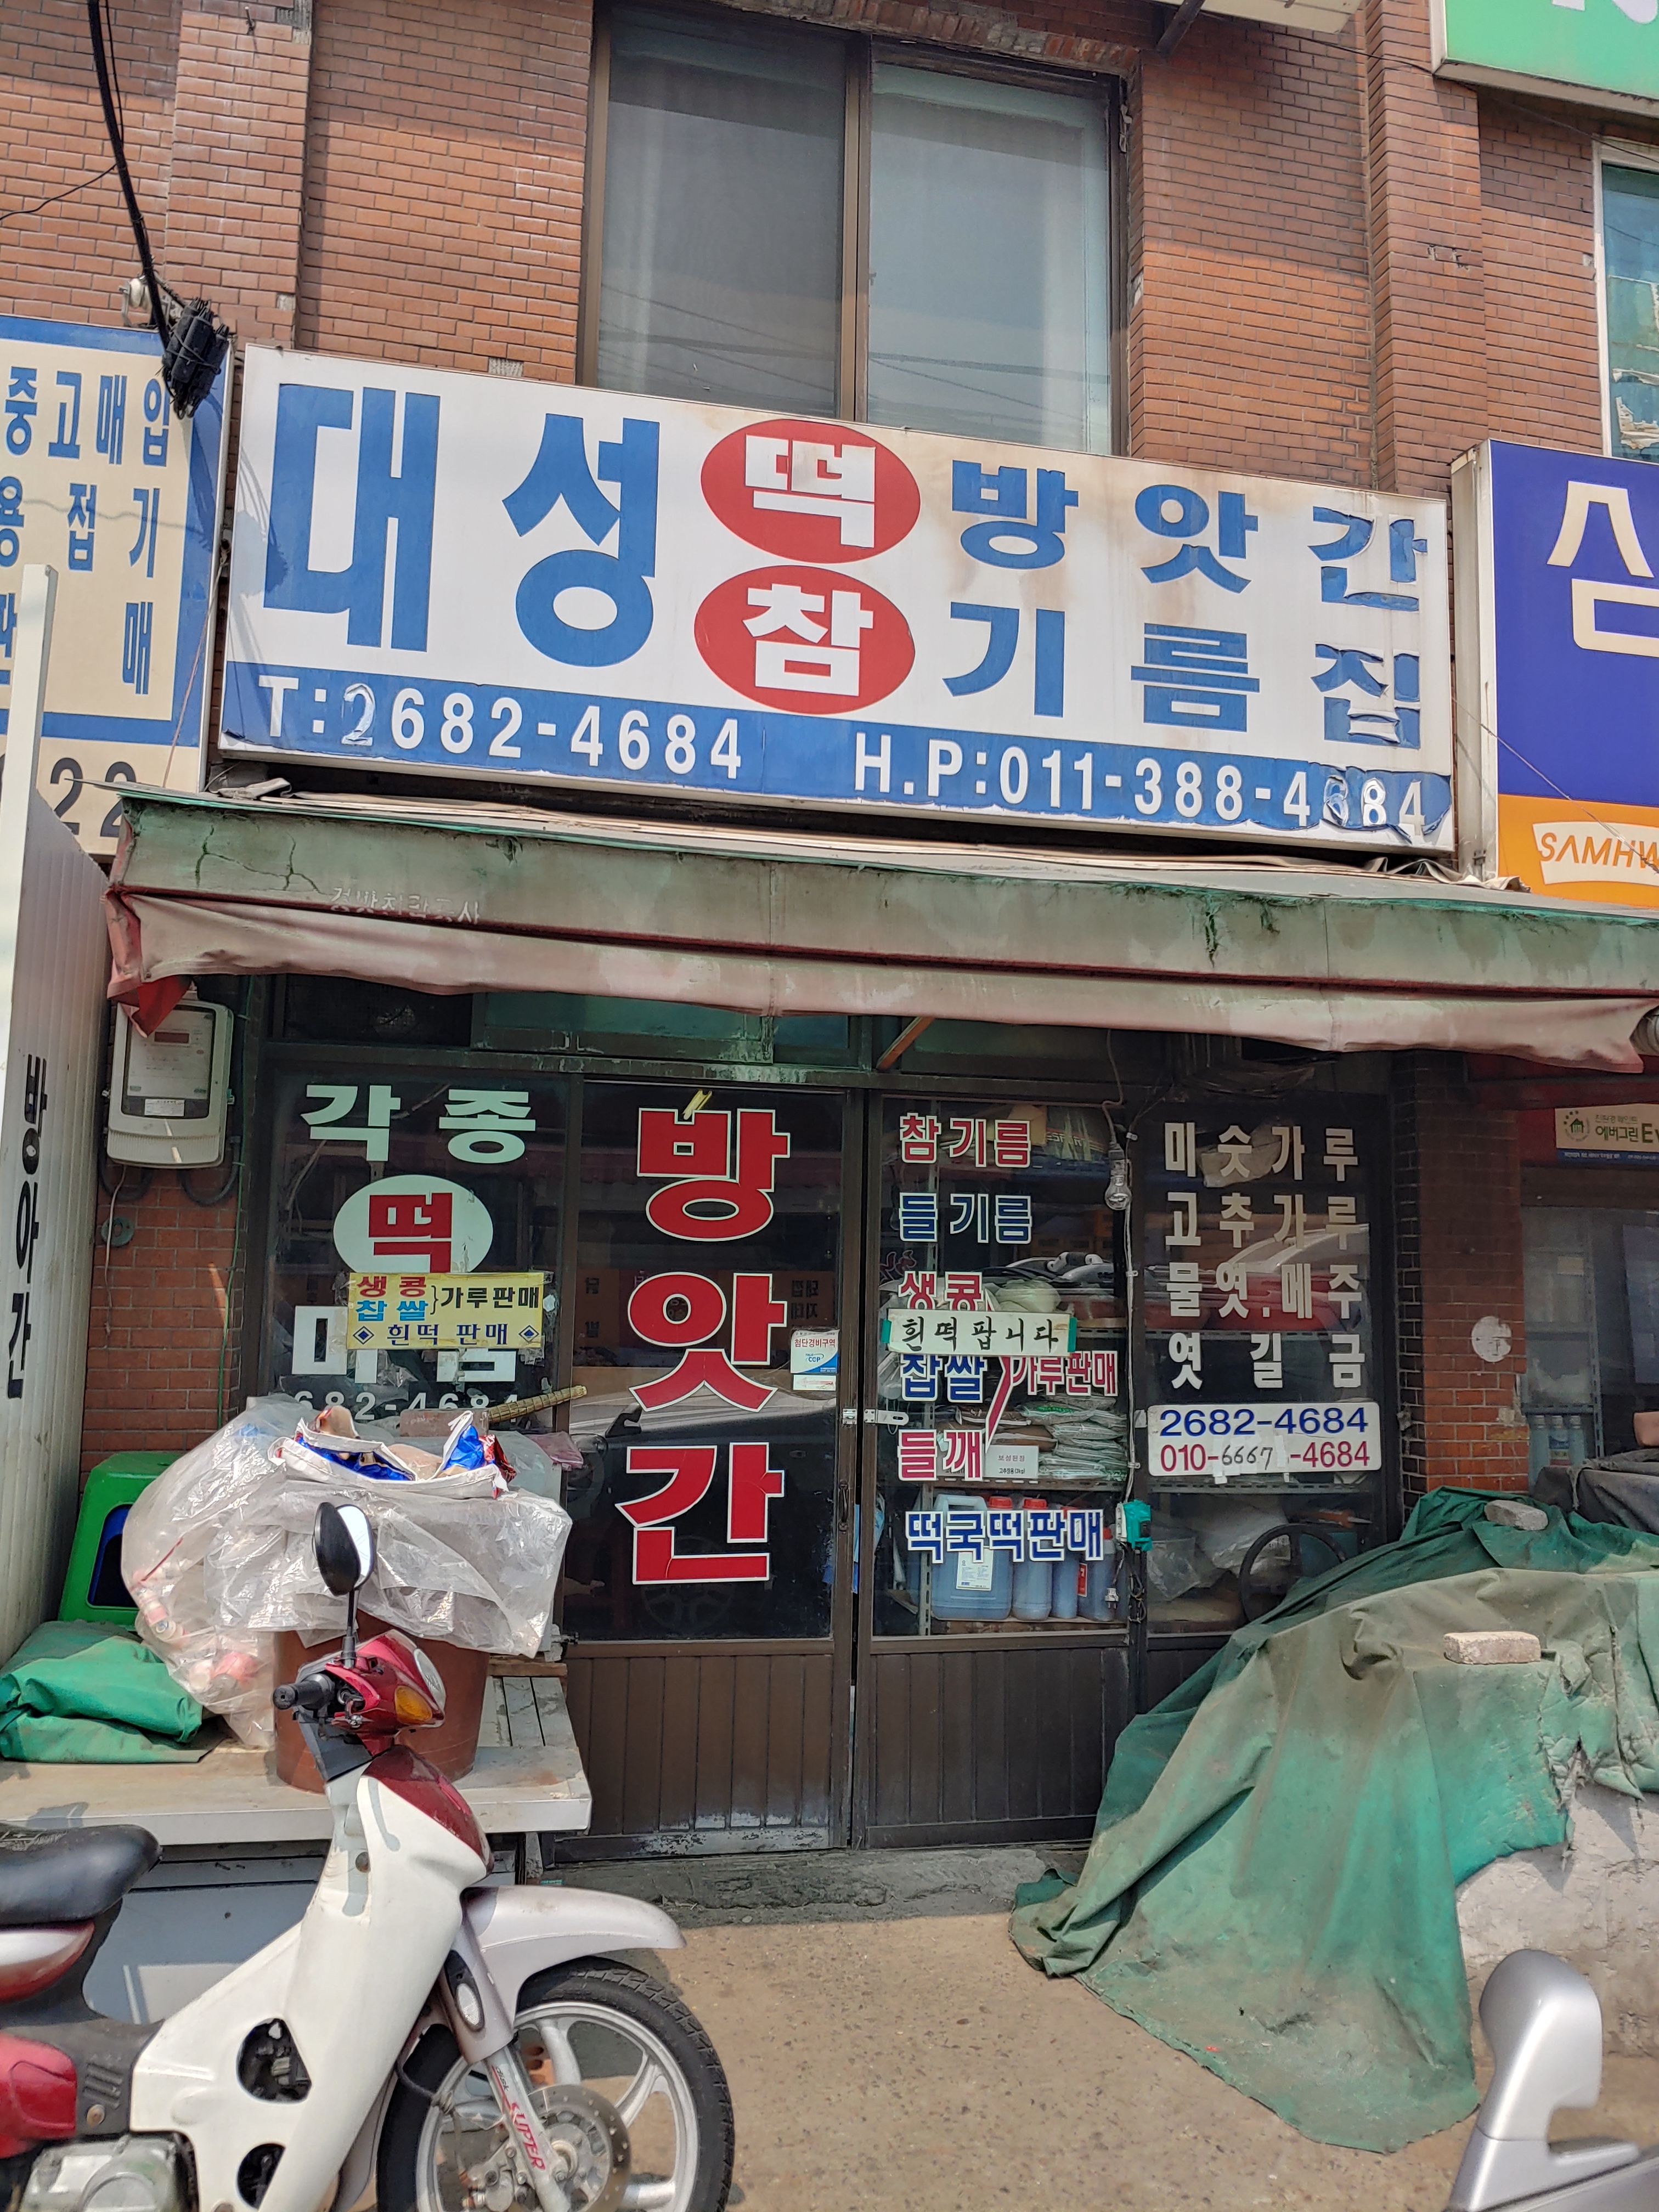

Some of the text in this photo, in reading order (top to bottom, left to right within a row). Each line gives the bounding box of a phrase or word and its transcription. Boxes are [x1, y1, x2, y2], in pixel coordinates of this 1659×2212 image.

[263, 383, 660, 668] 대성
[0, 753, 137, 837] 22
[300, 1084, 536, 1164] 각종
[899, 1112, 1032, 1169] 참기름
[1595, 1126, 1639, 1142] 에버그린
[1164, 1122, 1358, 1182] 미숫가루
[369, 1192, 453, 1273] 떡
[899, 1192, 1032, 1244] 들기름
[1165, 1192, 1362, 1250] 고추가루
[356, 1300, 429, 1322] 찹쌀
[357, 1276, 426, 1297] 생콩
[441, 1285, 540, 1309] 가루판매
[898, 1271, 983, 1310] 생콩
[387, 1323, 509, 1346] 흰떡 판매
[614, 1108, 791, 1584] 방앗간
[794, 1339, 836, 1348] 첨단경비구역
[1169, 1332, 1365, 1390] 엿길금
[1159, 1406, 1369, 1437] 2682-4684
[898, 1429, 983, 1481] 들깨
[905, 1509, 1104, 1564] 떡국떡판매
[495, 2067, 509, 2091] disk
